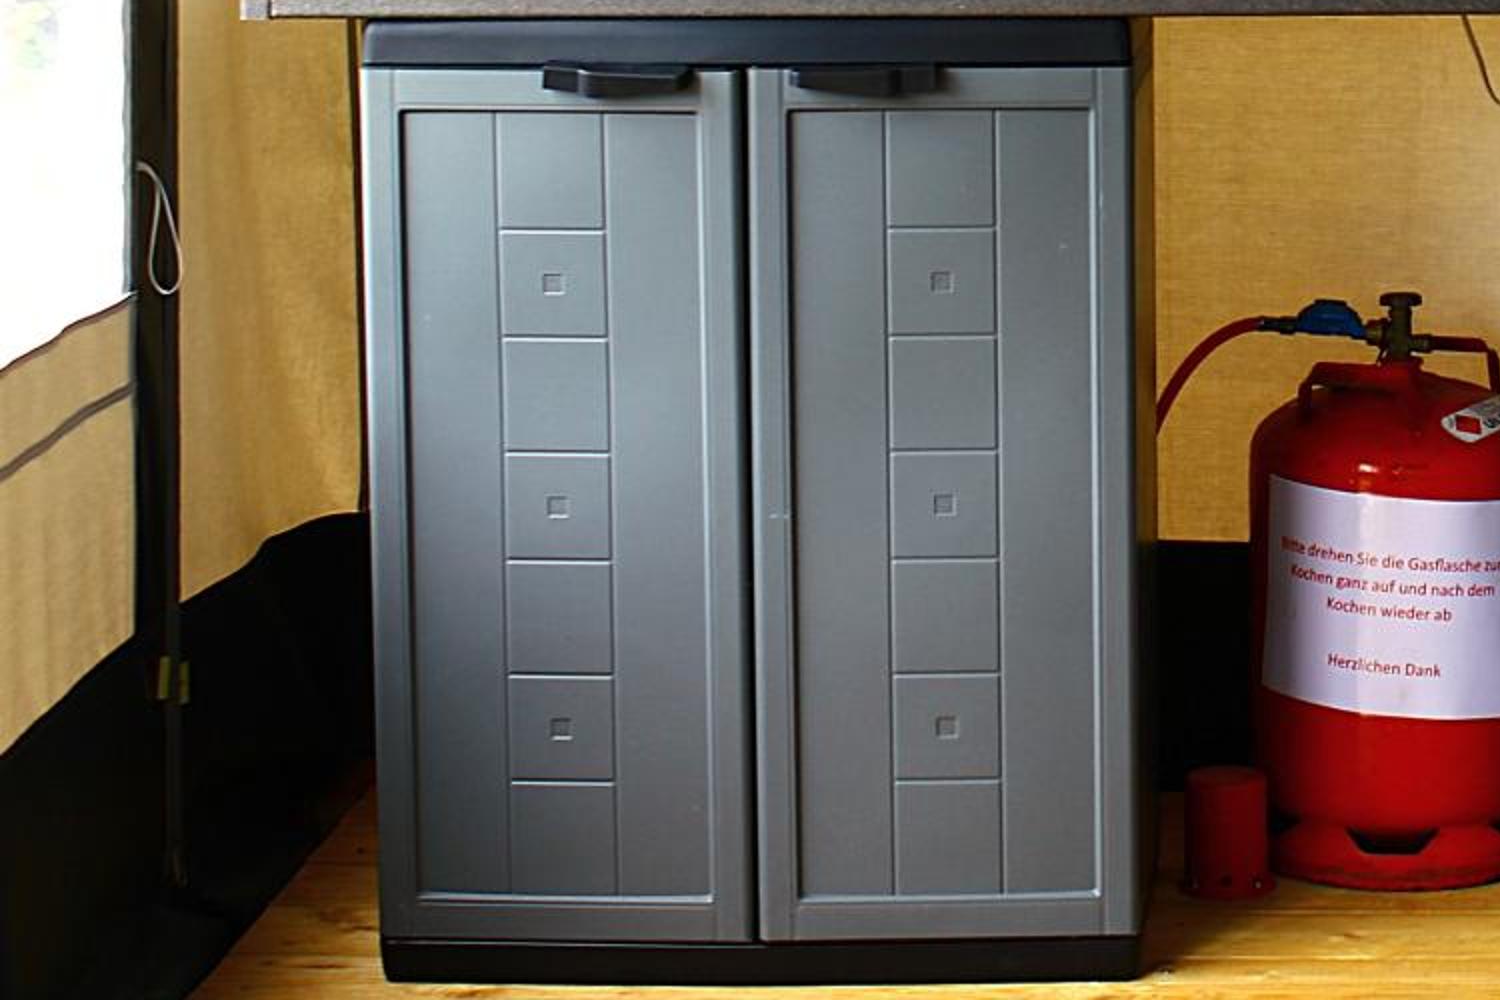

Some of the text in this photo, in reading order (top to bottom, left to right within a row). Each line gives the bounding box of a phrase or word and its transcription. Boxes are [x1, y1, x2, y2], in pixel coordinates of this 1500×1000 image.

[1308, 543, 1353, 565] drehen
[1356, 551, 1378, 567] Sie
[1382, 554, 1404, 569] die
[1408, 557, 1481, 573] Gasflasche
[1290, 563, 1495, 597] Kochen ganz auf und nach dem
[1326, 596, 1452, 622] Kochen wieder ab
[1327, 653, 1441, 677] Herzlichen Dank
